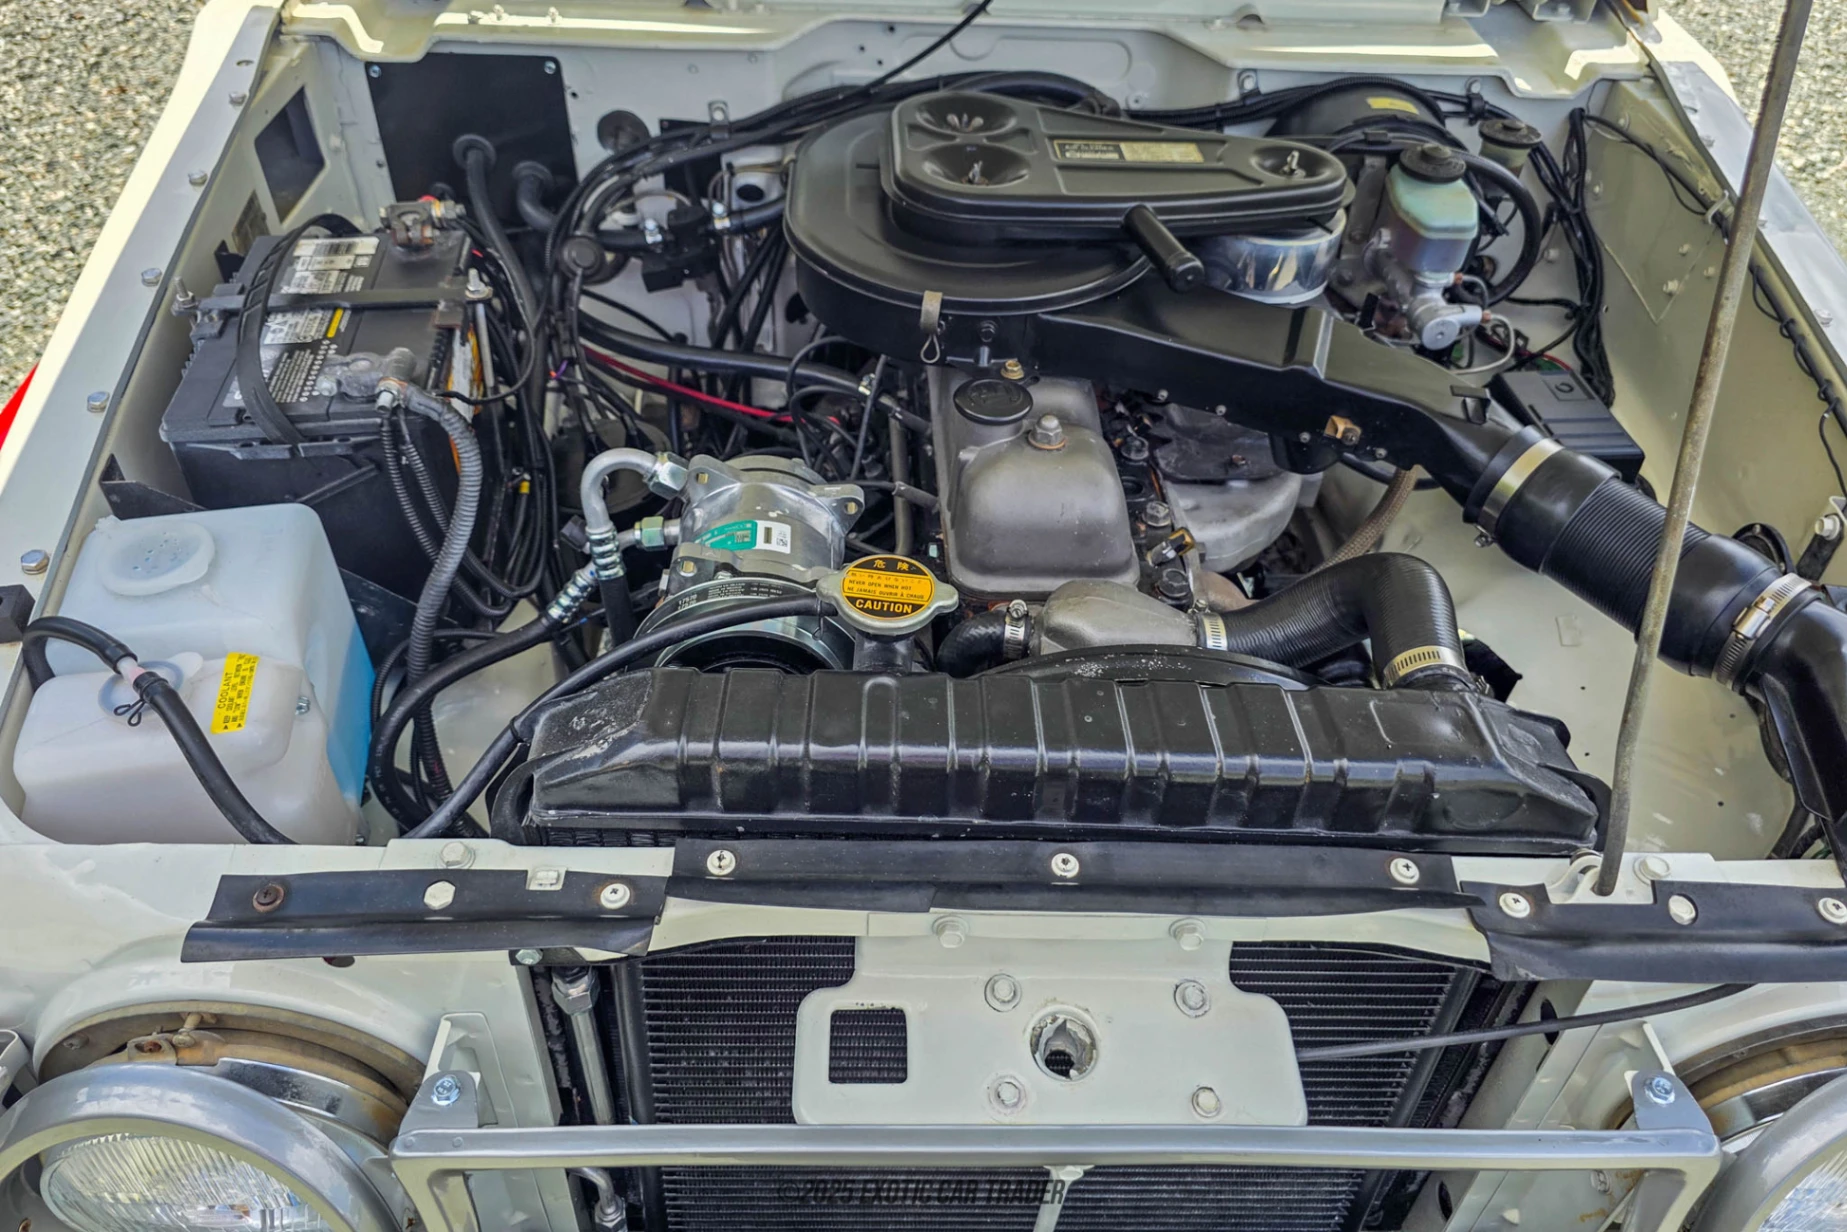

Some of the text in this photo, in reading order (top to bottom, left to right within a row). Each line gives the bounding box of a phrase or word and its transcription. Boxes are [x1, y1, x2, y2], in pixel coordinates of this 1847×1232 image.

[873, 559, 909, 571] 危険
[855, 599, 913, 614] CAUTION
[218, 672, 233, 709] COOLANT
